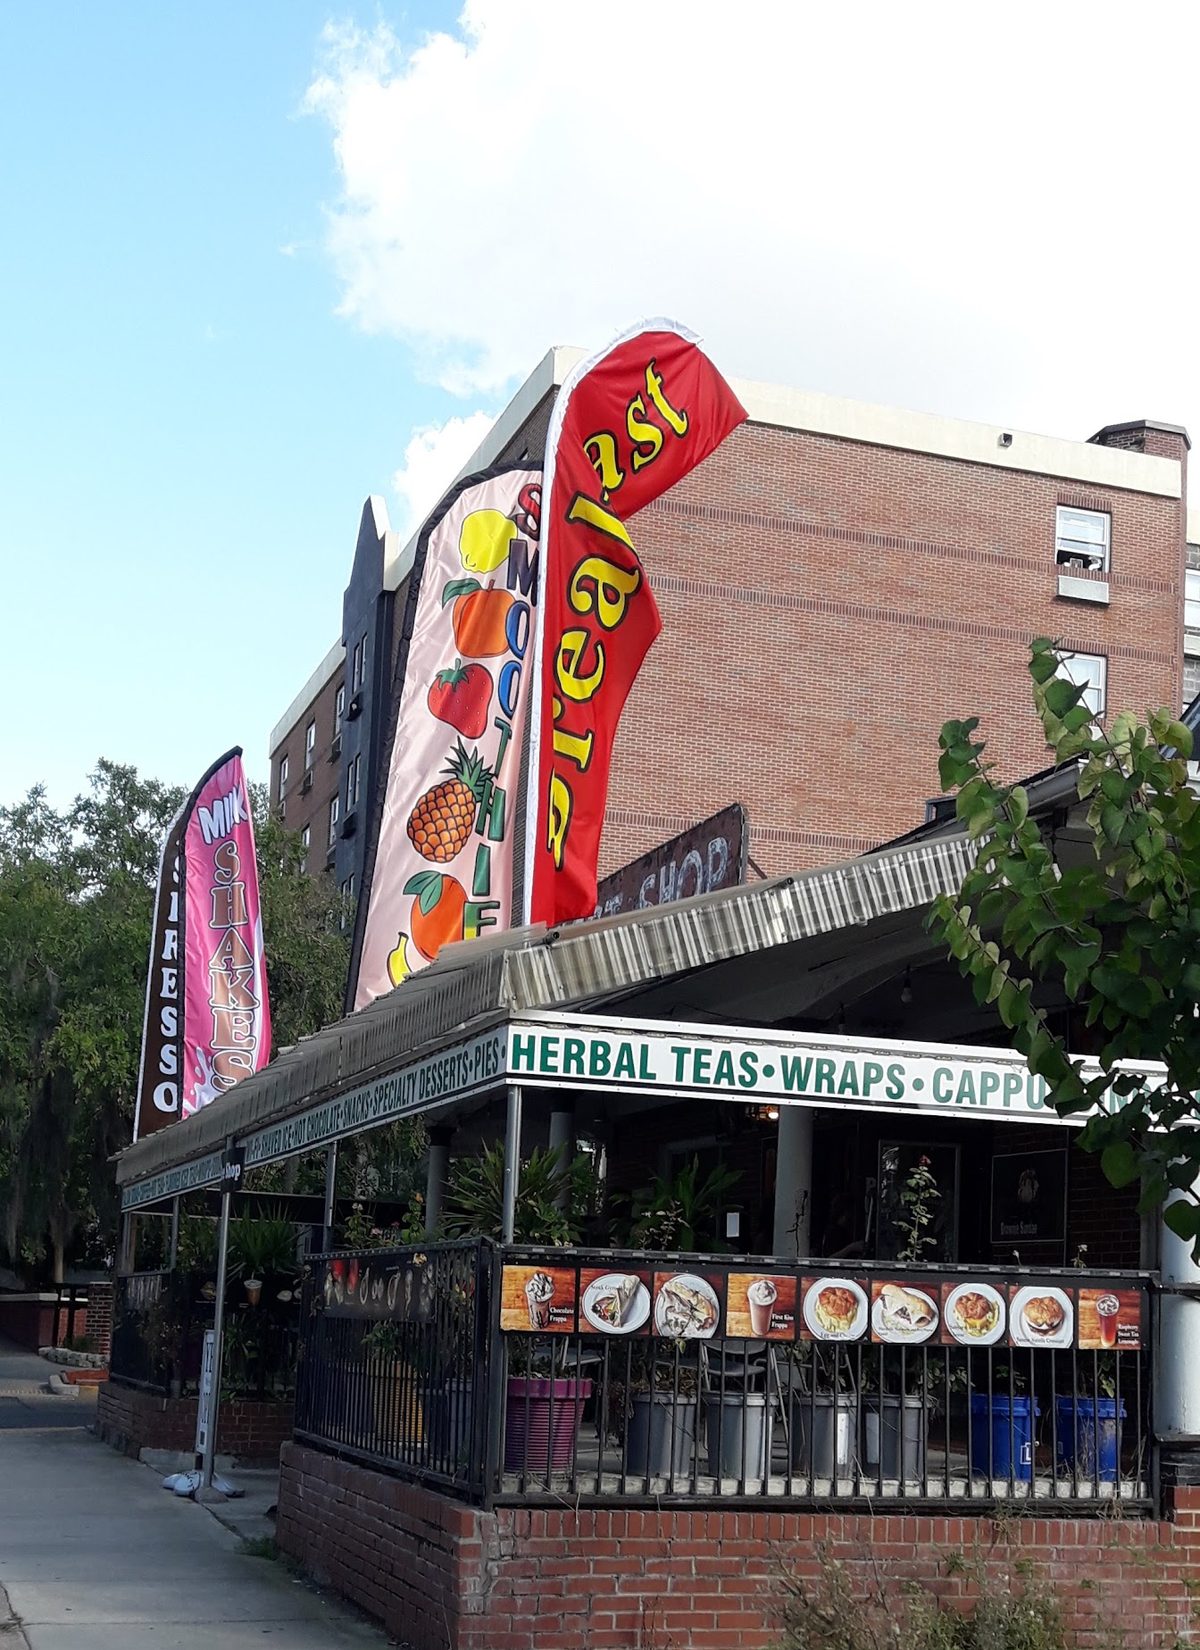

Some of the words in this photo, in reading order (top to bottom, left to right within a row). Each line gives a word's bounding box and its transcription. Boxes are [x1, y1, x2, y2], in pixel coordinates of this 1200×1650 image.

[210, 839, 260, 1094] SHAKES
[307, 1104, 340, 1141] CHOCOLATE
[343, 1090, 371, 1128] SNACKS
[373, 1071, 417, 1116] SPECIALTY
[419, 1050, 469, 1100] DESSERTS
[474, 1036, 499, 1081] PIES
[511, 1033, 657, 1081] HERBAL
[671, 1046, 758, 1088] TEAS
[780, 1054, 906, 1100] WRAPS
